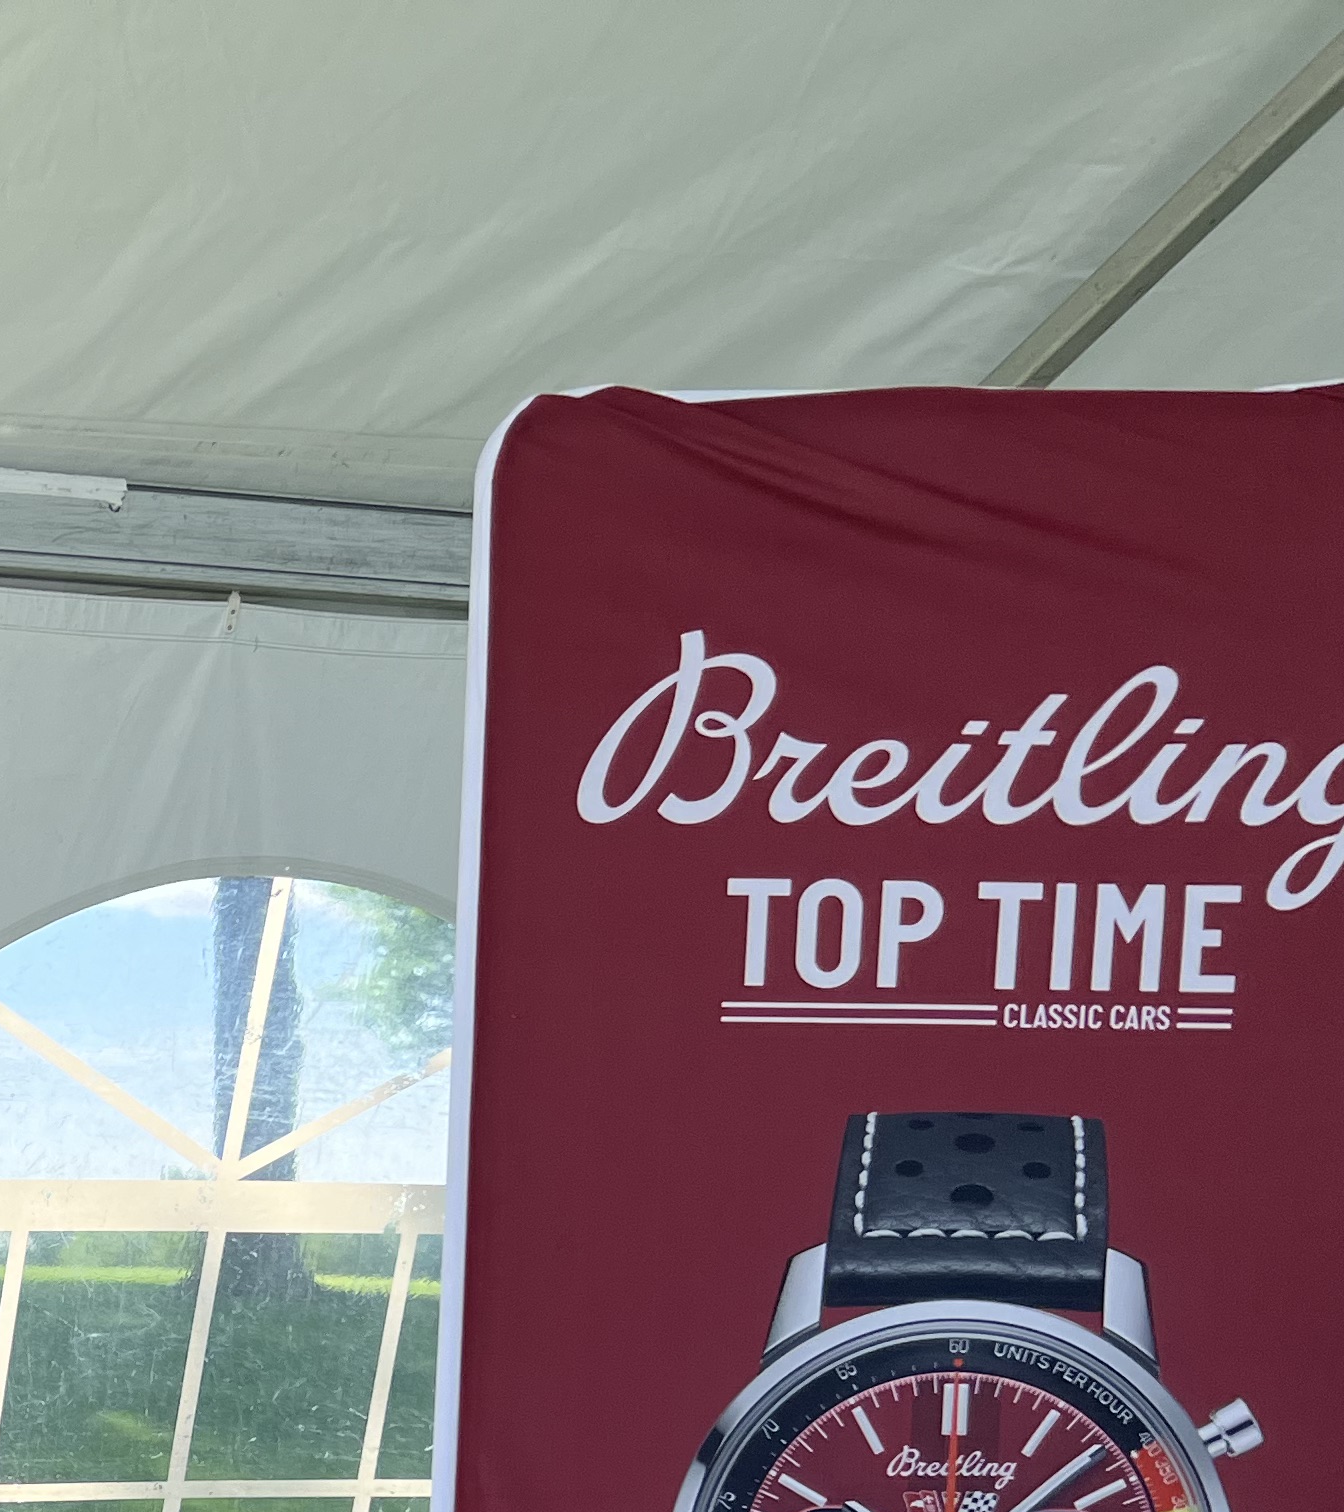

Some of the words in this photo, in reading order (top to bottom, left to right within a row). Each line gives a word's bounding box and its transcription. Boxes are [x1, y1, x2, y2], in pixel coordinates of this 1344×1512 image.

[576, 629, 1344, 911] Breitling
[726, 878, 945, 989] TOP
[978, 882, 1242, 993] TIME
[1003, 1003, 1103, 1031] CLASSIC
[1109, 1005, 1171, 1031] CARS
[949, 1339, 969, 1354] 60
[835, 1363, 858, 1381] 65
[993, 1342, 1051, 1369] UNITS
[1052, 1361, 1089, 1389] PER
[1087, 1381, 1134, 1425] HOUR
[762, 1418, 780, 1440] 70
[1139, 1432, 1162, 1458] 400
[1155, 1457, 1179, 1485] 350
[719, 1491, 736, 1510] 75
